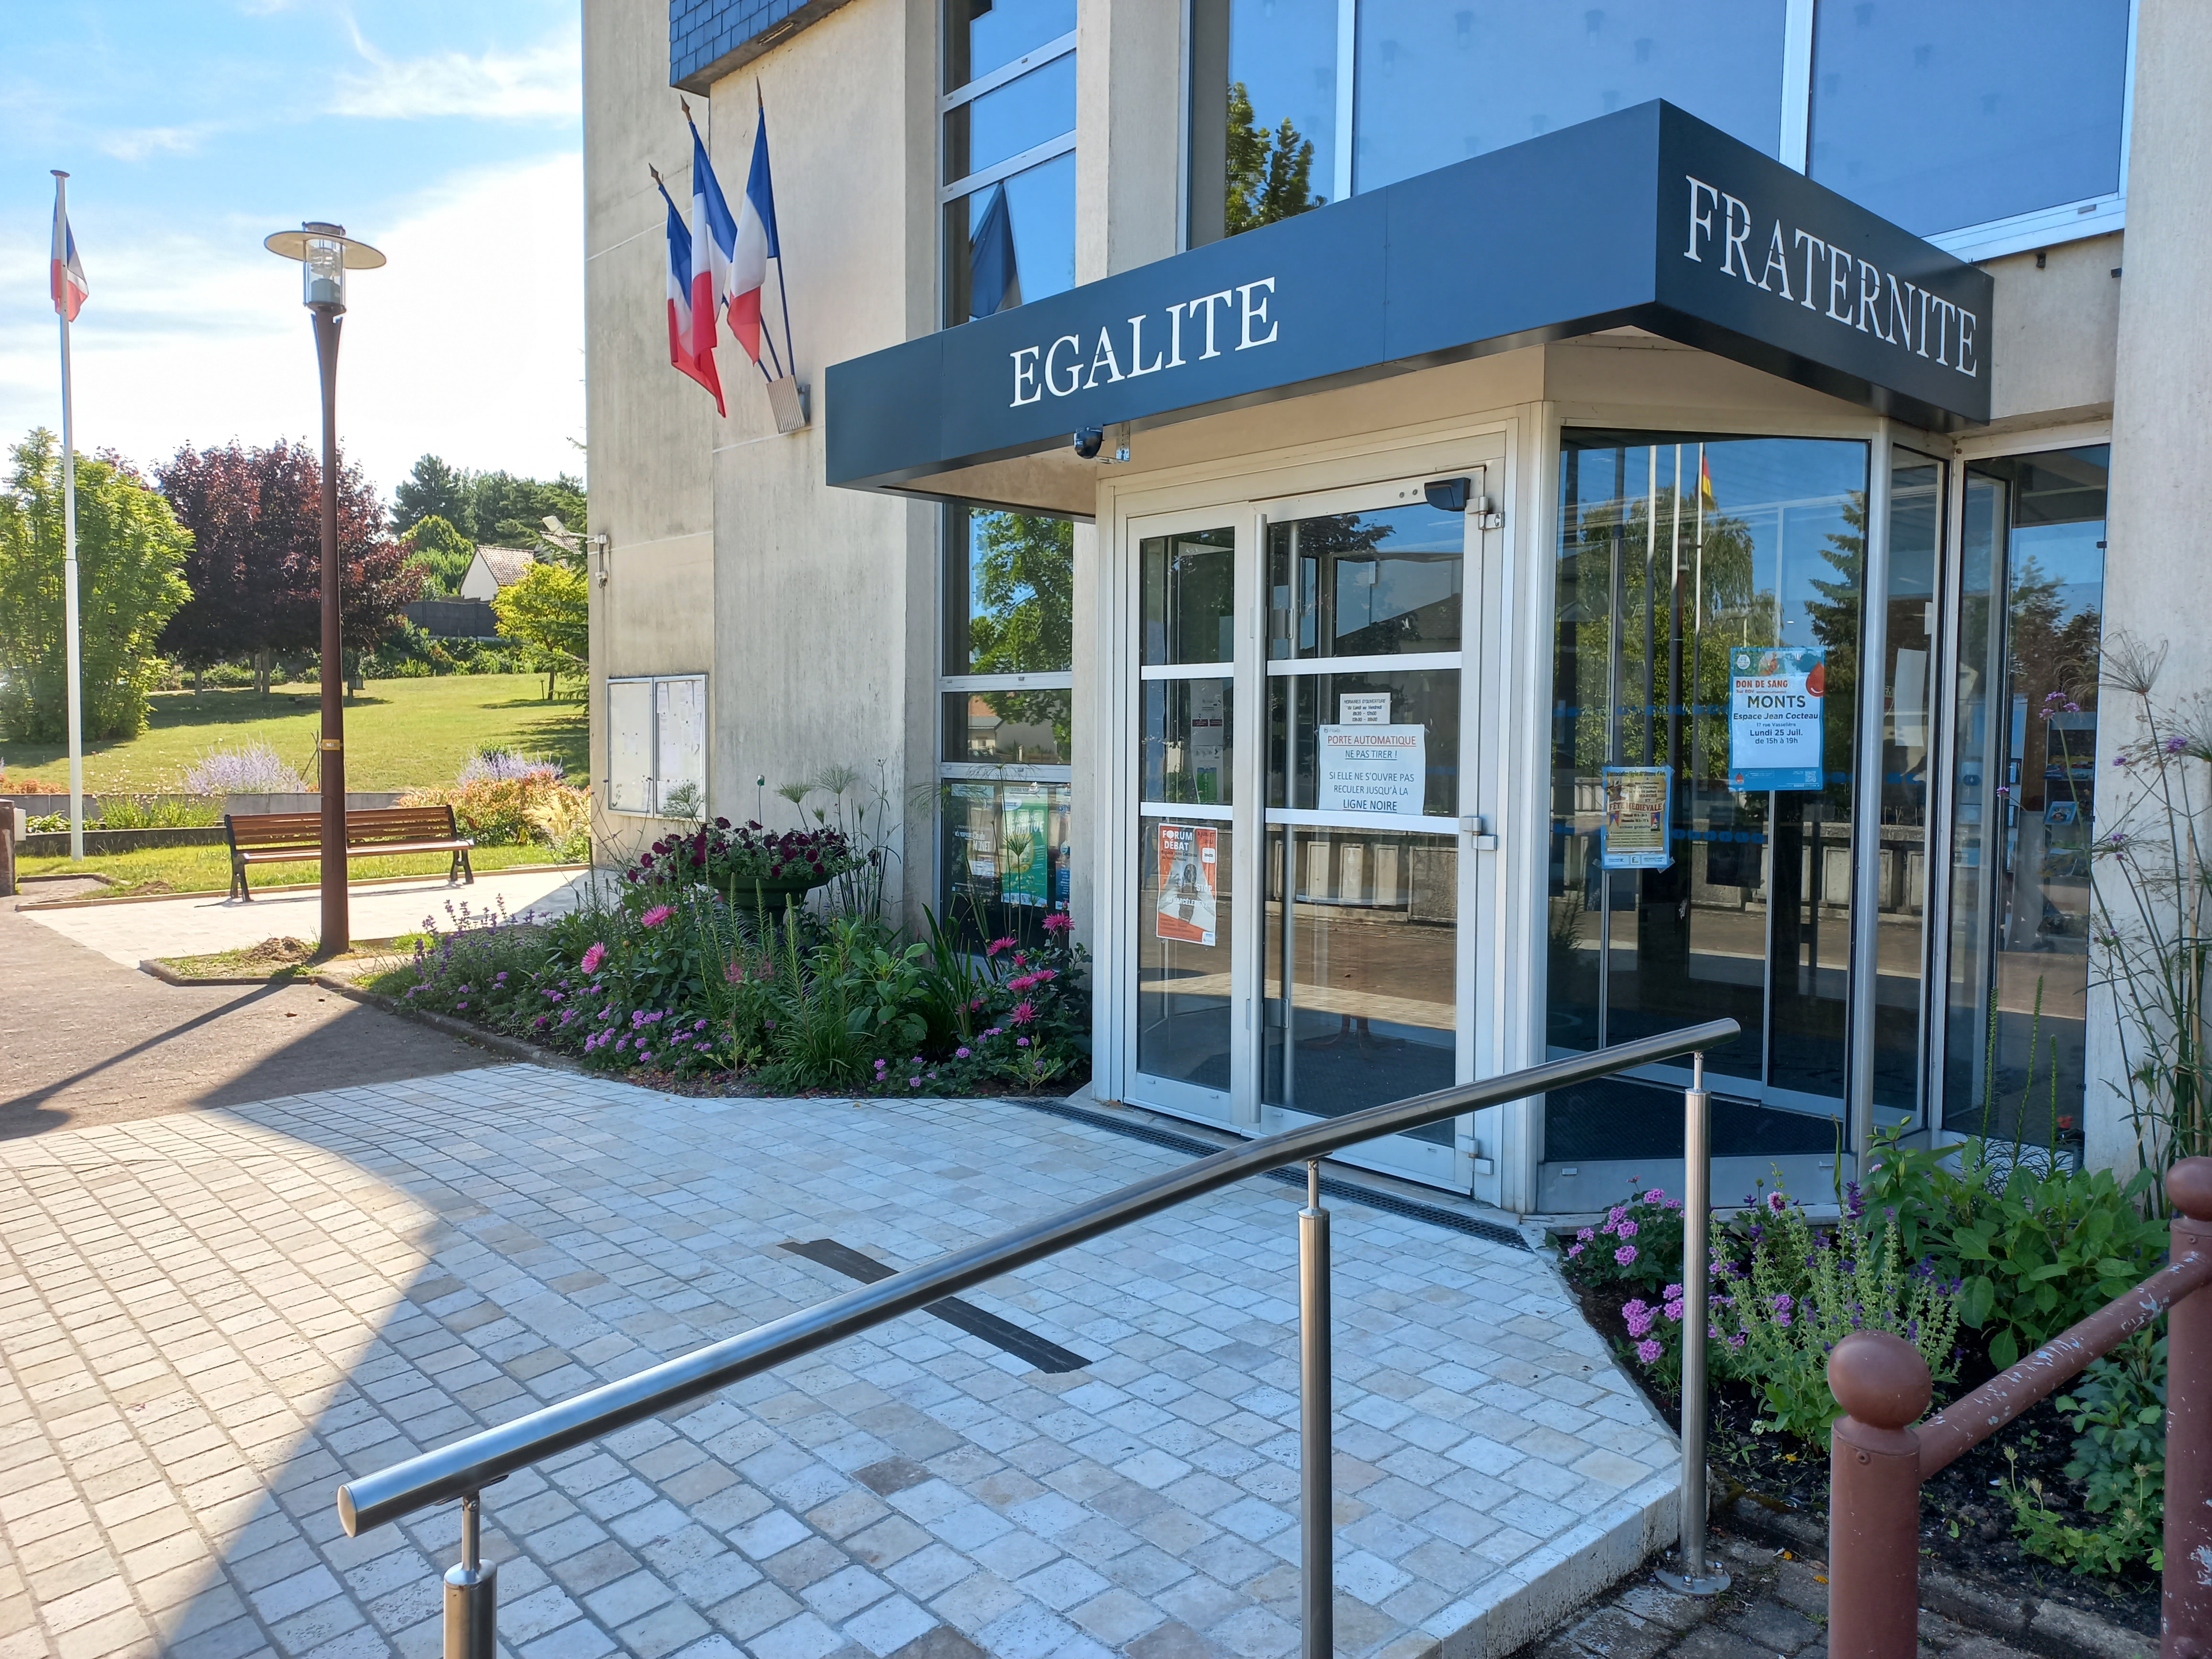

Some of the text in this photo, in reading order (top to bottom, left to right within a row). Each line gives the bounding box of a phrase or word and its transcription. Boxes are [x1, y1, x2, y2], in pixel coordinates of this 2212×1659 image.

[1683, 175, 1977, 377] FRATERNITE
[1009, 276, 1278, 408] EGALITE
[1736, 680, 1752, 688] DON
[1747, 695, 1806, 708] MONTS
[1327, 735, 1416, 746] PORTE AUTOMATIQUE
[1345, 750, 1354, 758] NE
[1356, 750, 1370, 758] PAS
[1371, 750, 1392, 759] TIRER
[1338, 772, 1352, 780] ELLE
[1354, 773, 1364, 781] NE
[1365, 773, 1397, 782] S'OUVRE
[1400, 774, 1415, 782] PAS
[1334, 785, 1408, 796] RECULER JUSQU'À LA
[1343, 799, 1397, 811] LIGNE NOIRE
[1609, 801, 1625, 811] FÊTE
[1162, 830, 1193, 841] FORUM
[973, 840, 991, 852] MONET
[1164, 839, 1189, 851] DÉBAT
[1196, 884, 1213, 892] STOP
